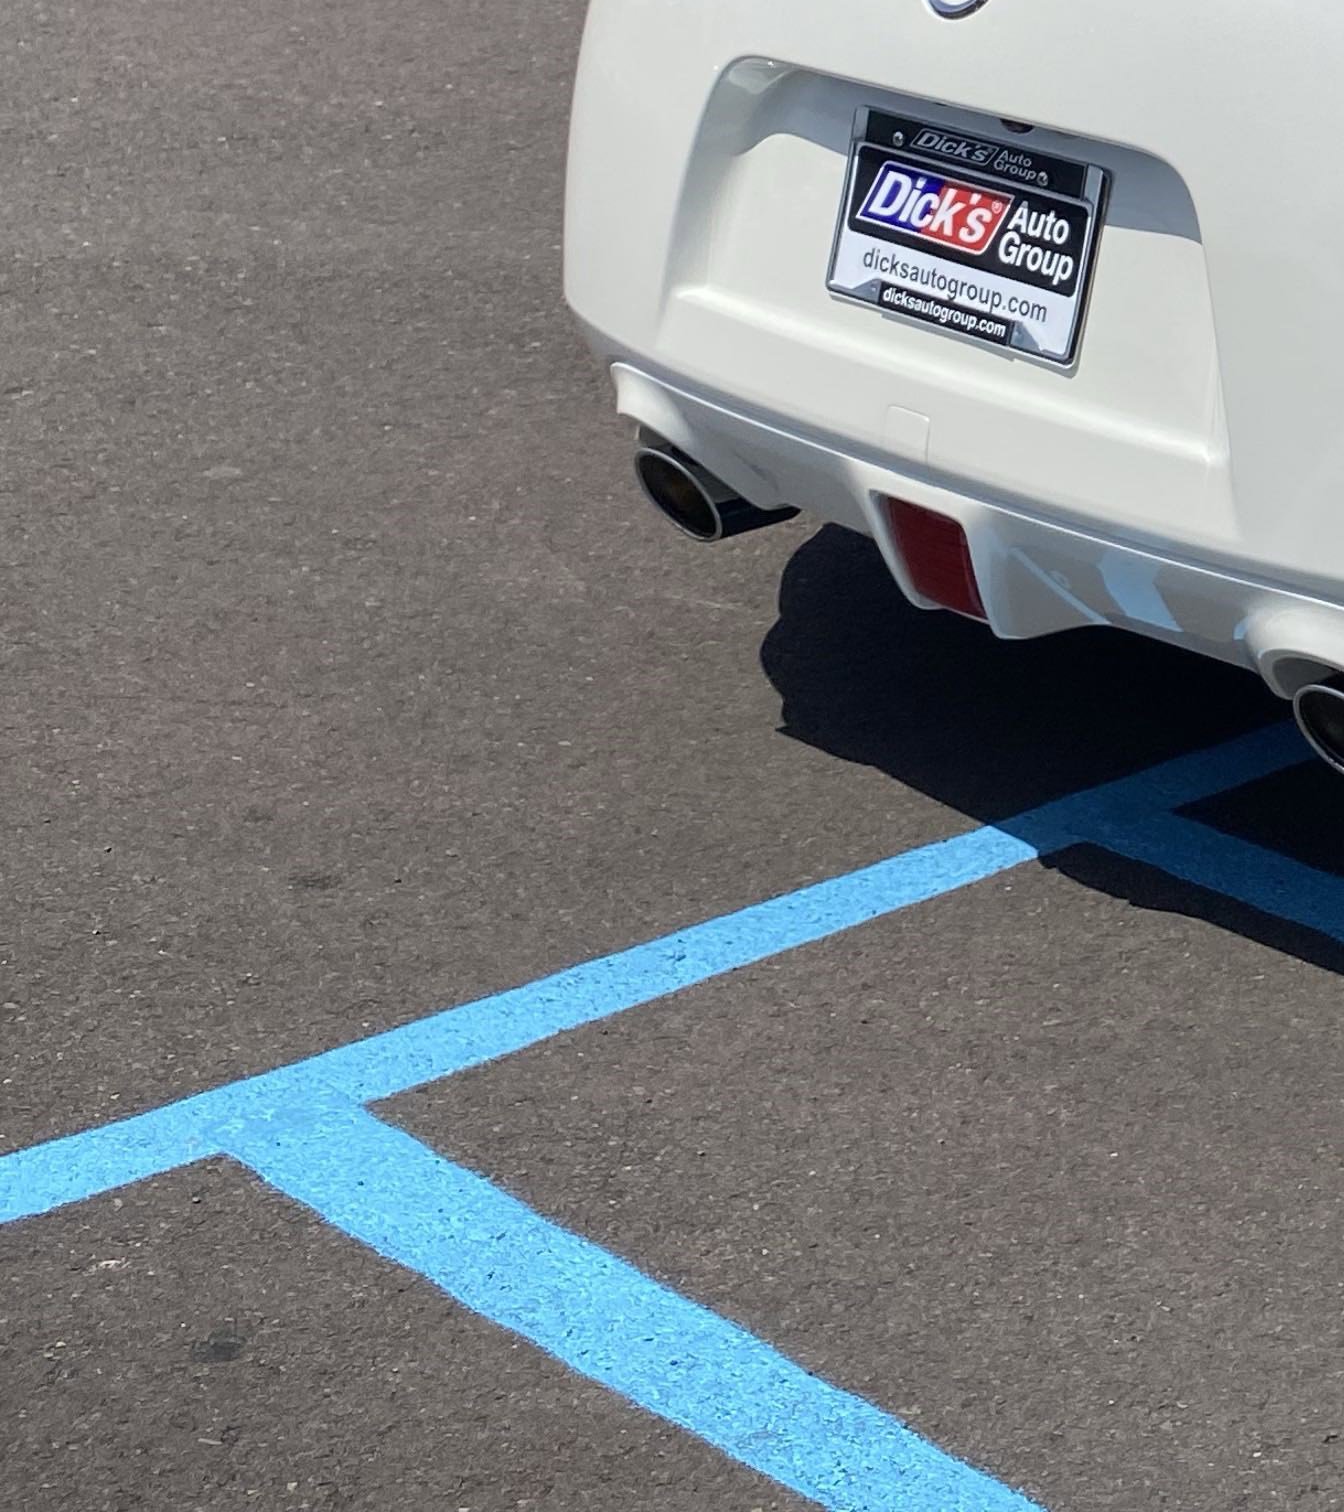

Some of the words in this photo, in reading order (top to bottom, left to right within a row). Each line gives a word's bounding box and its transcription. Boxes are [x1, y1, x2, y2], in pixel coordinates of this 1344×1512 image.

[916, 131, 990, 162] Dick's
[993, 159, 1038, 181] Group
[999, 149, 1033, 168] Auto
[867, 169, 993, 244] Dick's
[1007, 200, 1070, 245] Auto
[998, 230, 1074, 285] Group
[862, 246, 1048, 323] dicksautogroup.com
[881, 287, 1007, 337] dicksautogroup.com
